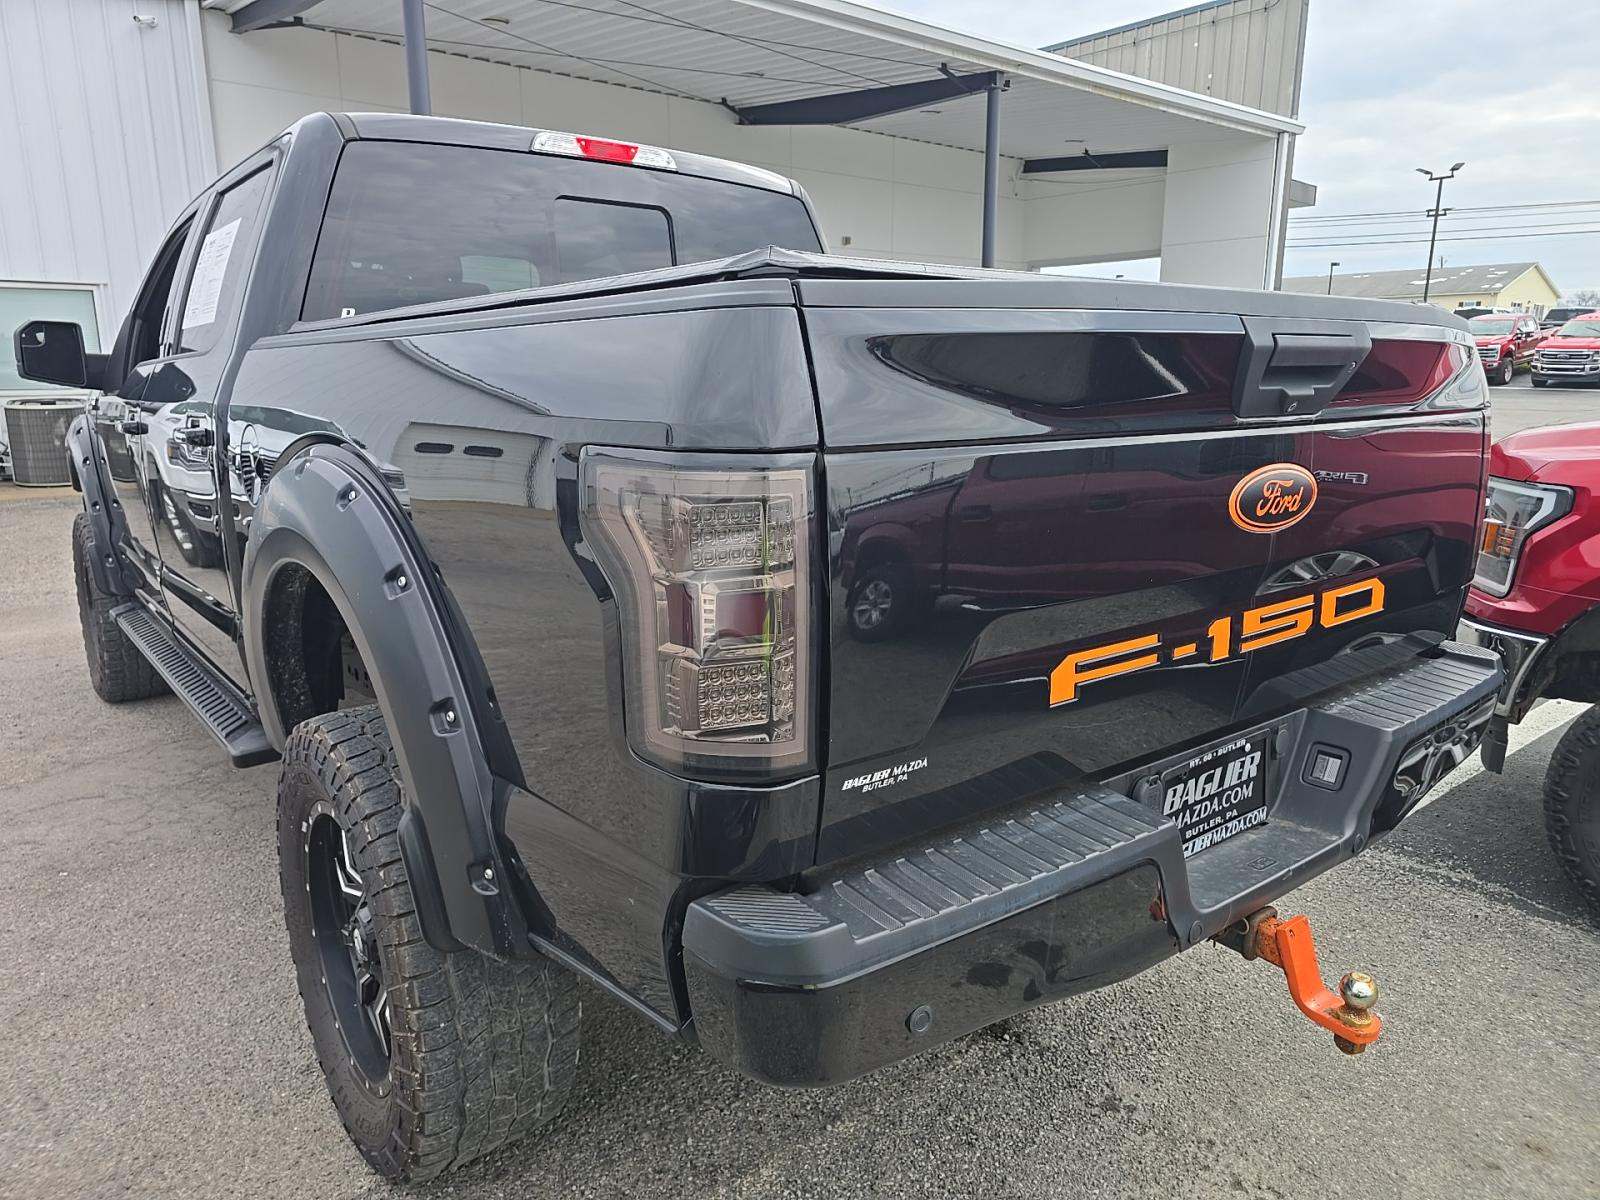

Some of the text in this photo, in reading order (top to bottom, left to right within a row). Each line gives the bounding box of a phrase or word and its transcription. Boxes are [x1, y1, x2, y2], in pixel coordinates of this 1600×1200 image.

[1256, 479, 1303, 517] Ford
[1050, 577, 1385, 708] F-150
[1217, 738, 1246, 757] BUTLER
[842, 757, 928, 791] BAGLIER MAZDA
[862, 773, 908, 793] BUTLER, PA
[1163, 751, 1261, 816] BAGLIER
[1172, 781, 1254, 829] MAZDA.COM
[1185, 808, 1238, 839] BUTLER, PA
